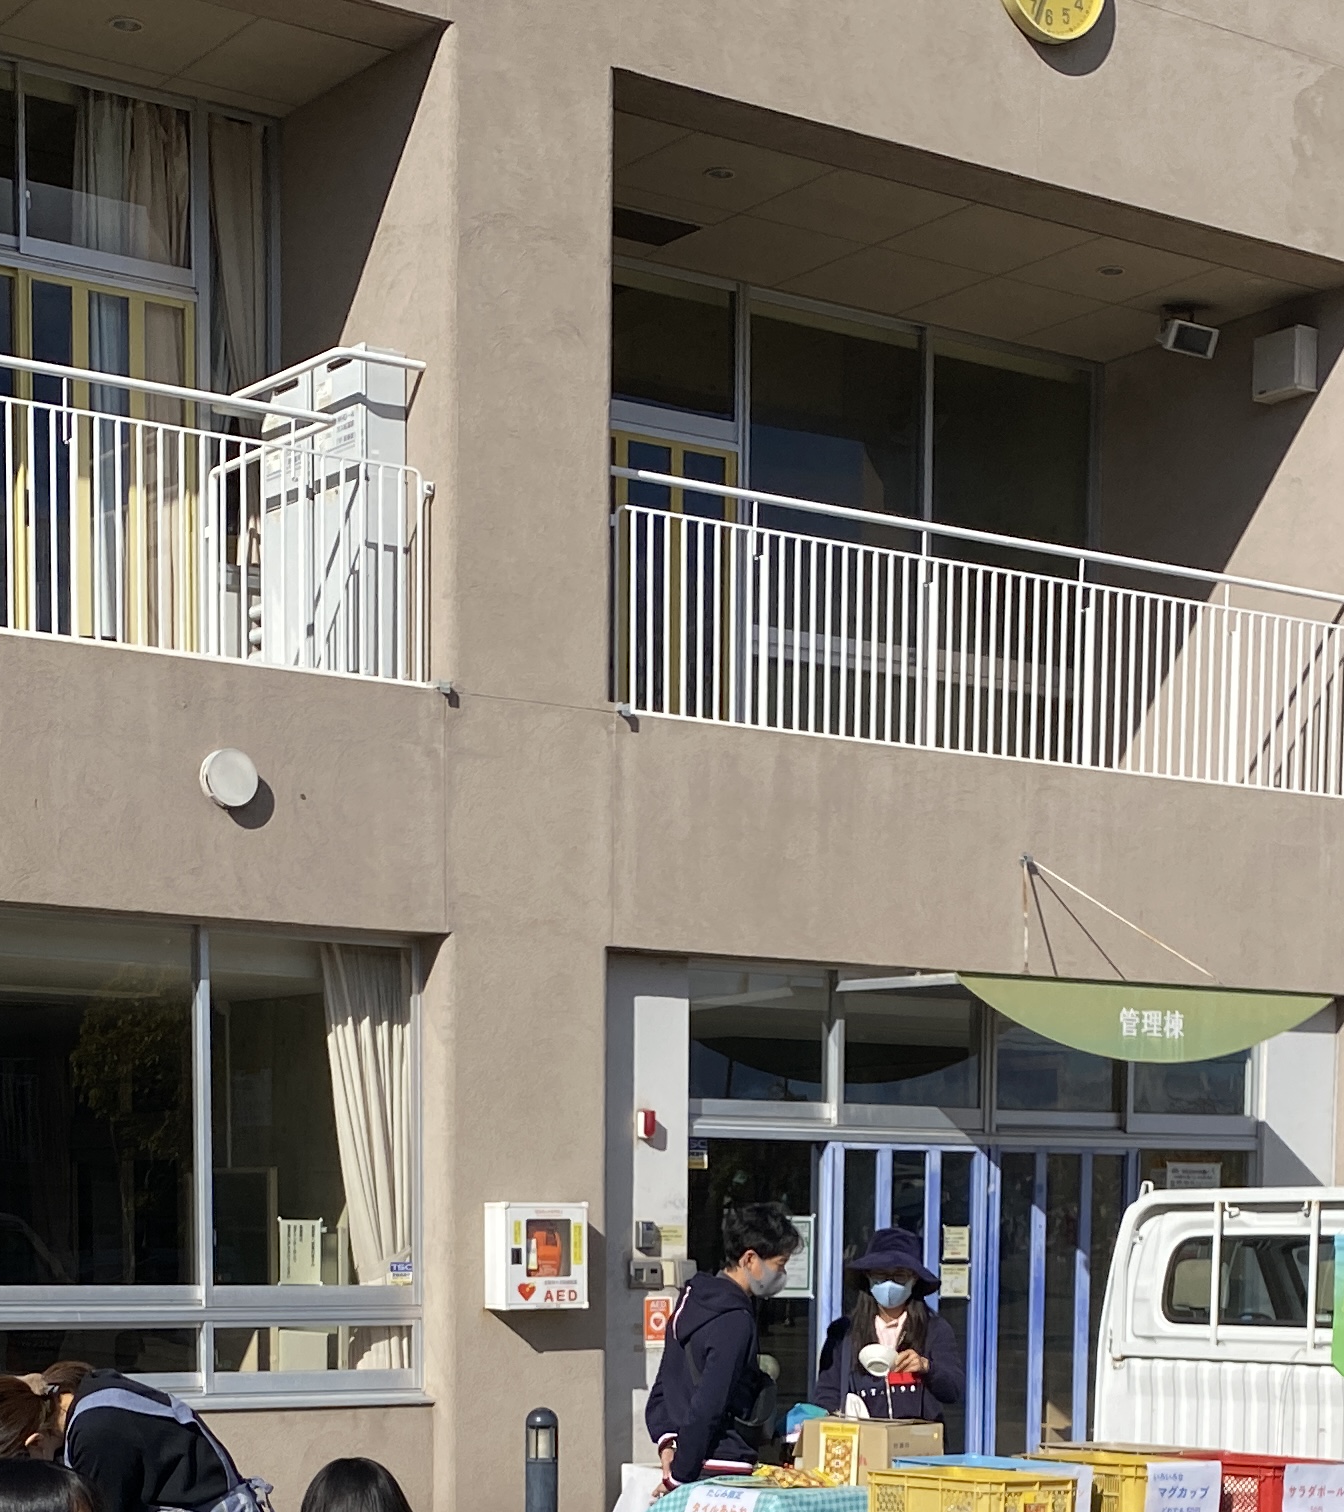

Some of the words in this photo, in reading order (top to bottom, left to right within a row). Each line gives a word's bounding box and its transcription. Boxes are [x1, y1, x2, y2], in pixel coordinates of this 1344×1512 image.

[1045, 9, 1054, 26] 6
[1062, 8, 1071, 25] 5
[1119, 1007, 1185, 1039] 管理棟
[544, 1289, 578, 1302] AED
[1158, 1485, 1210, 1500] マグカップ
